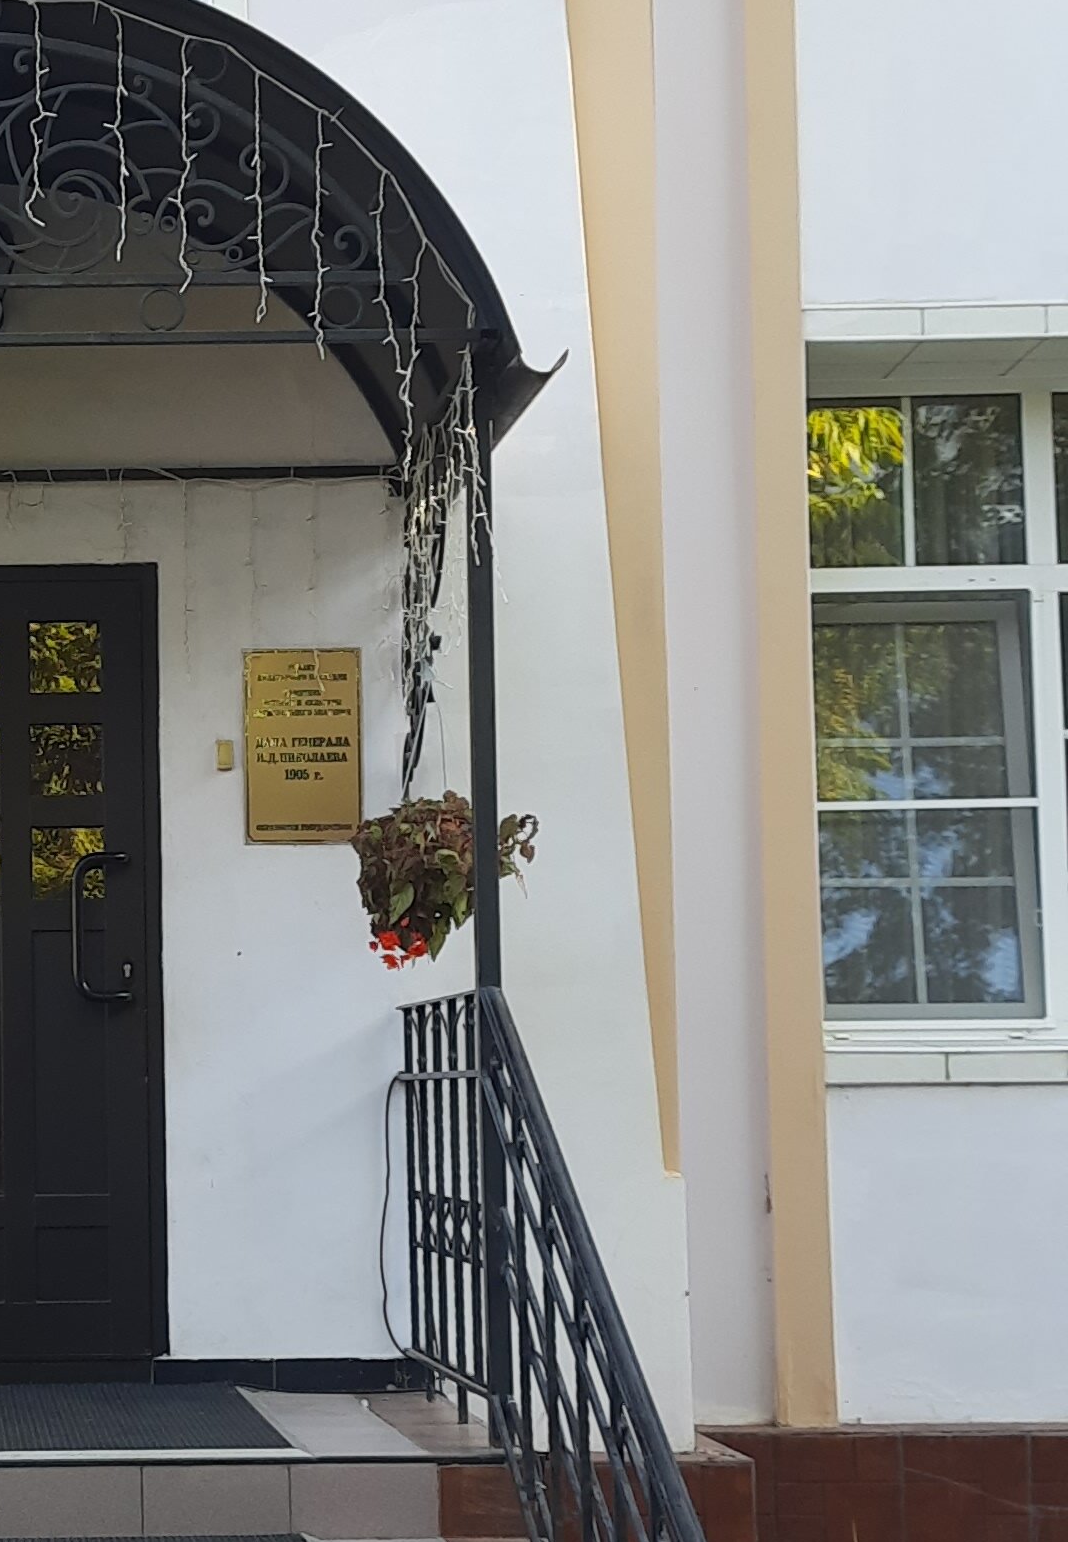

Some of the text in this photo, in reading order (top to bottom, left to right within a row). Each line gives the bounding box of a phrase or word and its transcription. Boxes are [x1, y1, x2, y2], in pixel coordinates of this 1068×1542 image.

[255, 736, 350, 749] ДАЧА ГЕНЕРАЛА
[284, 769, 309, 780] 1905
